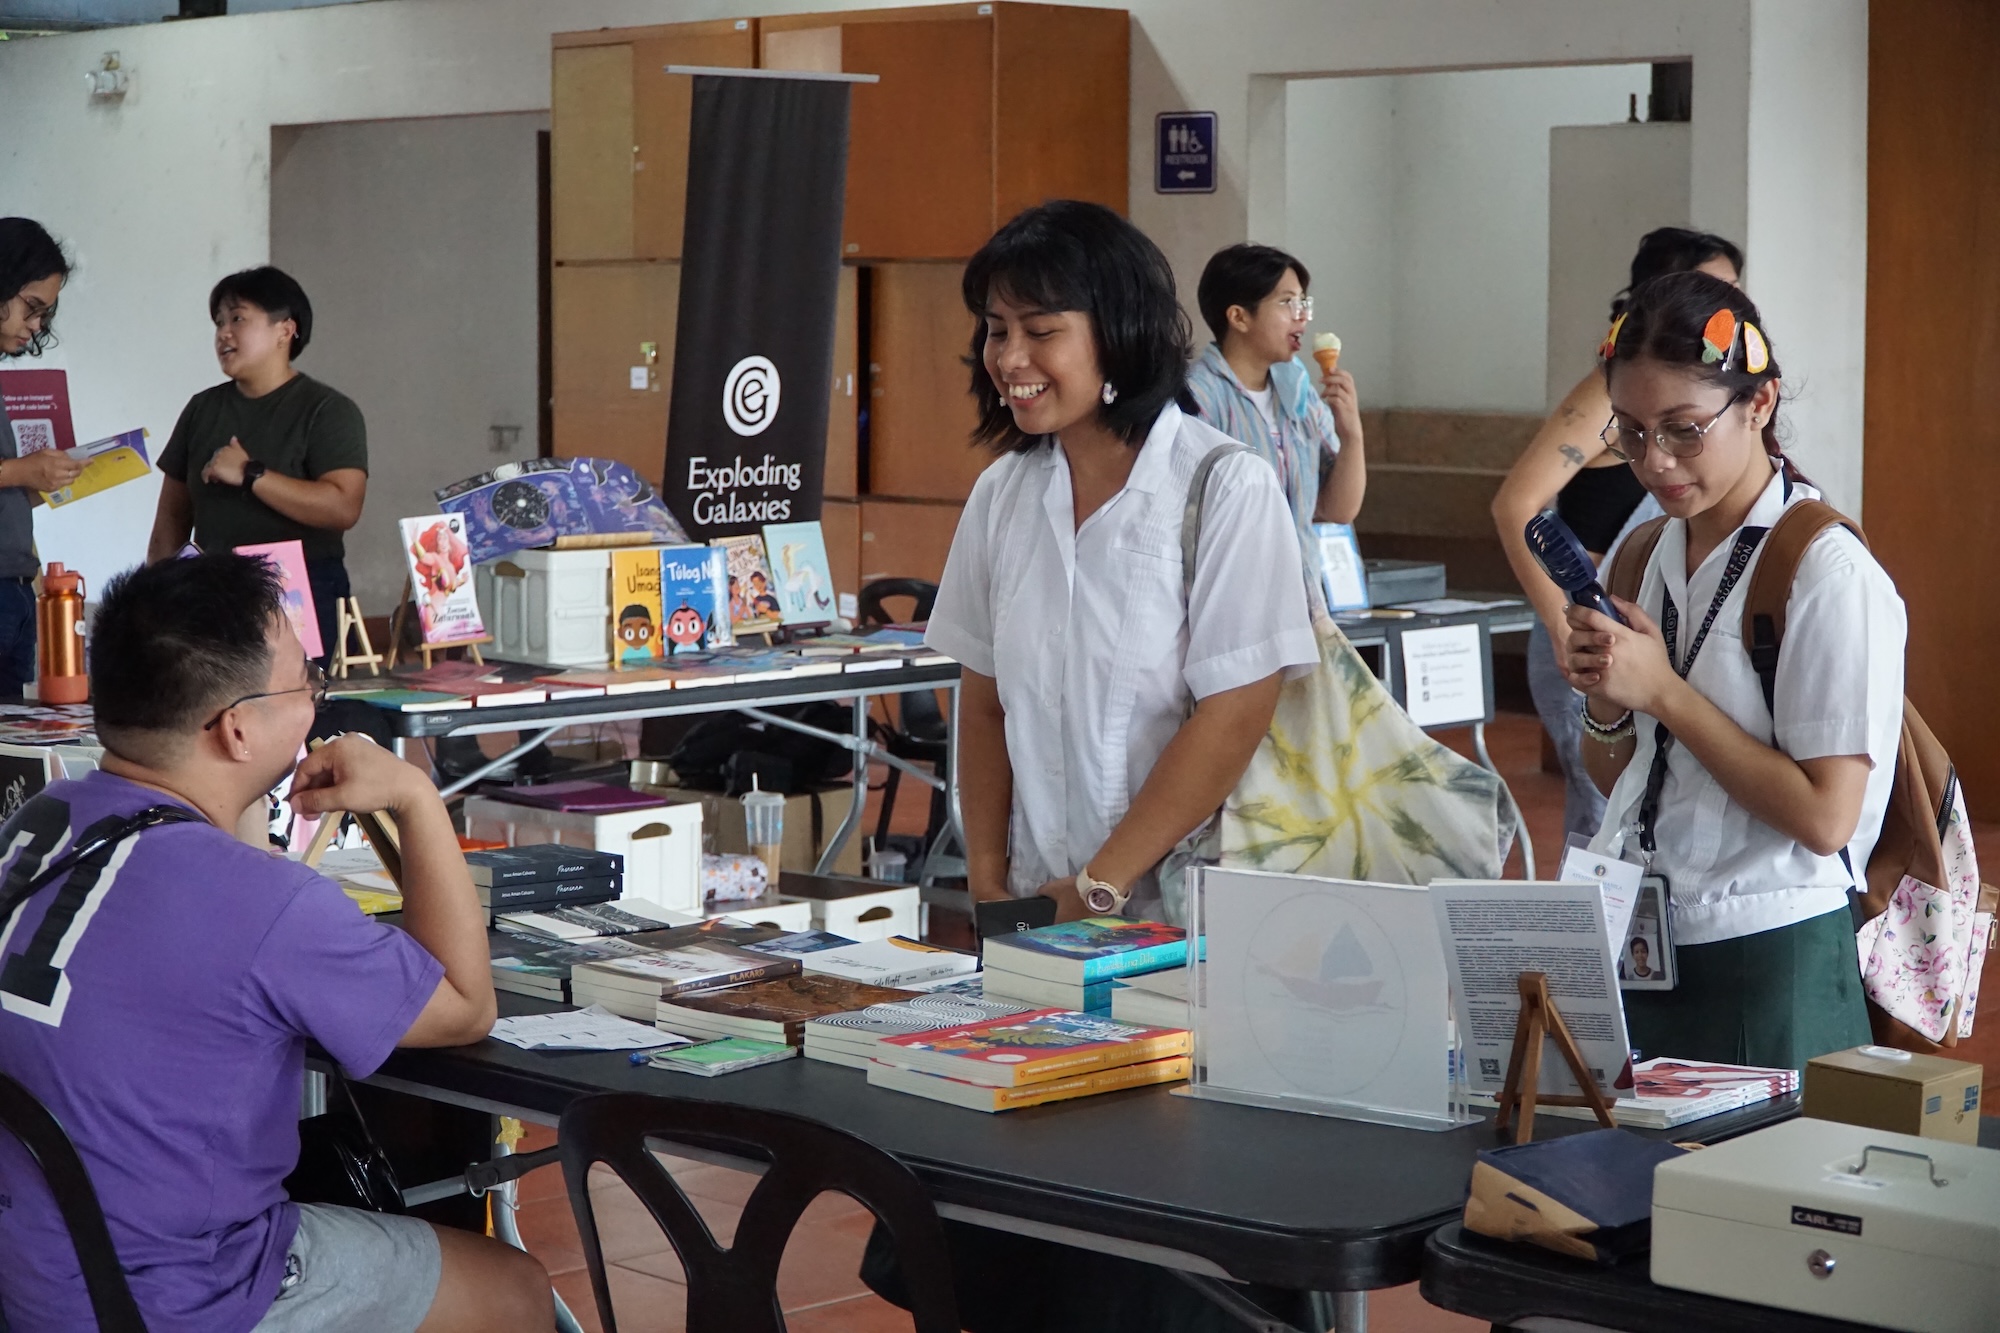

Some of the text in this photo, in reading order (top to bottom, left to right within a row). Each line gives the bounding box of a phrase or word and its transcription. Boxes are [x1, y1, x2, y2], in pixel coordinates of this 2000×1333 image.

[687, 454, 801, 495] Exploding
[693, 491, 791, 525] Galaxies
[666, 562, 701, 583] Túlog
[1715, 544, 1754, 611] EDUCATION
[729, 968, 765, 982] PLAKARD
